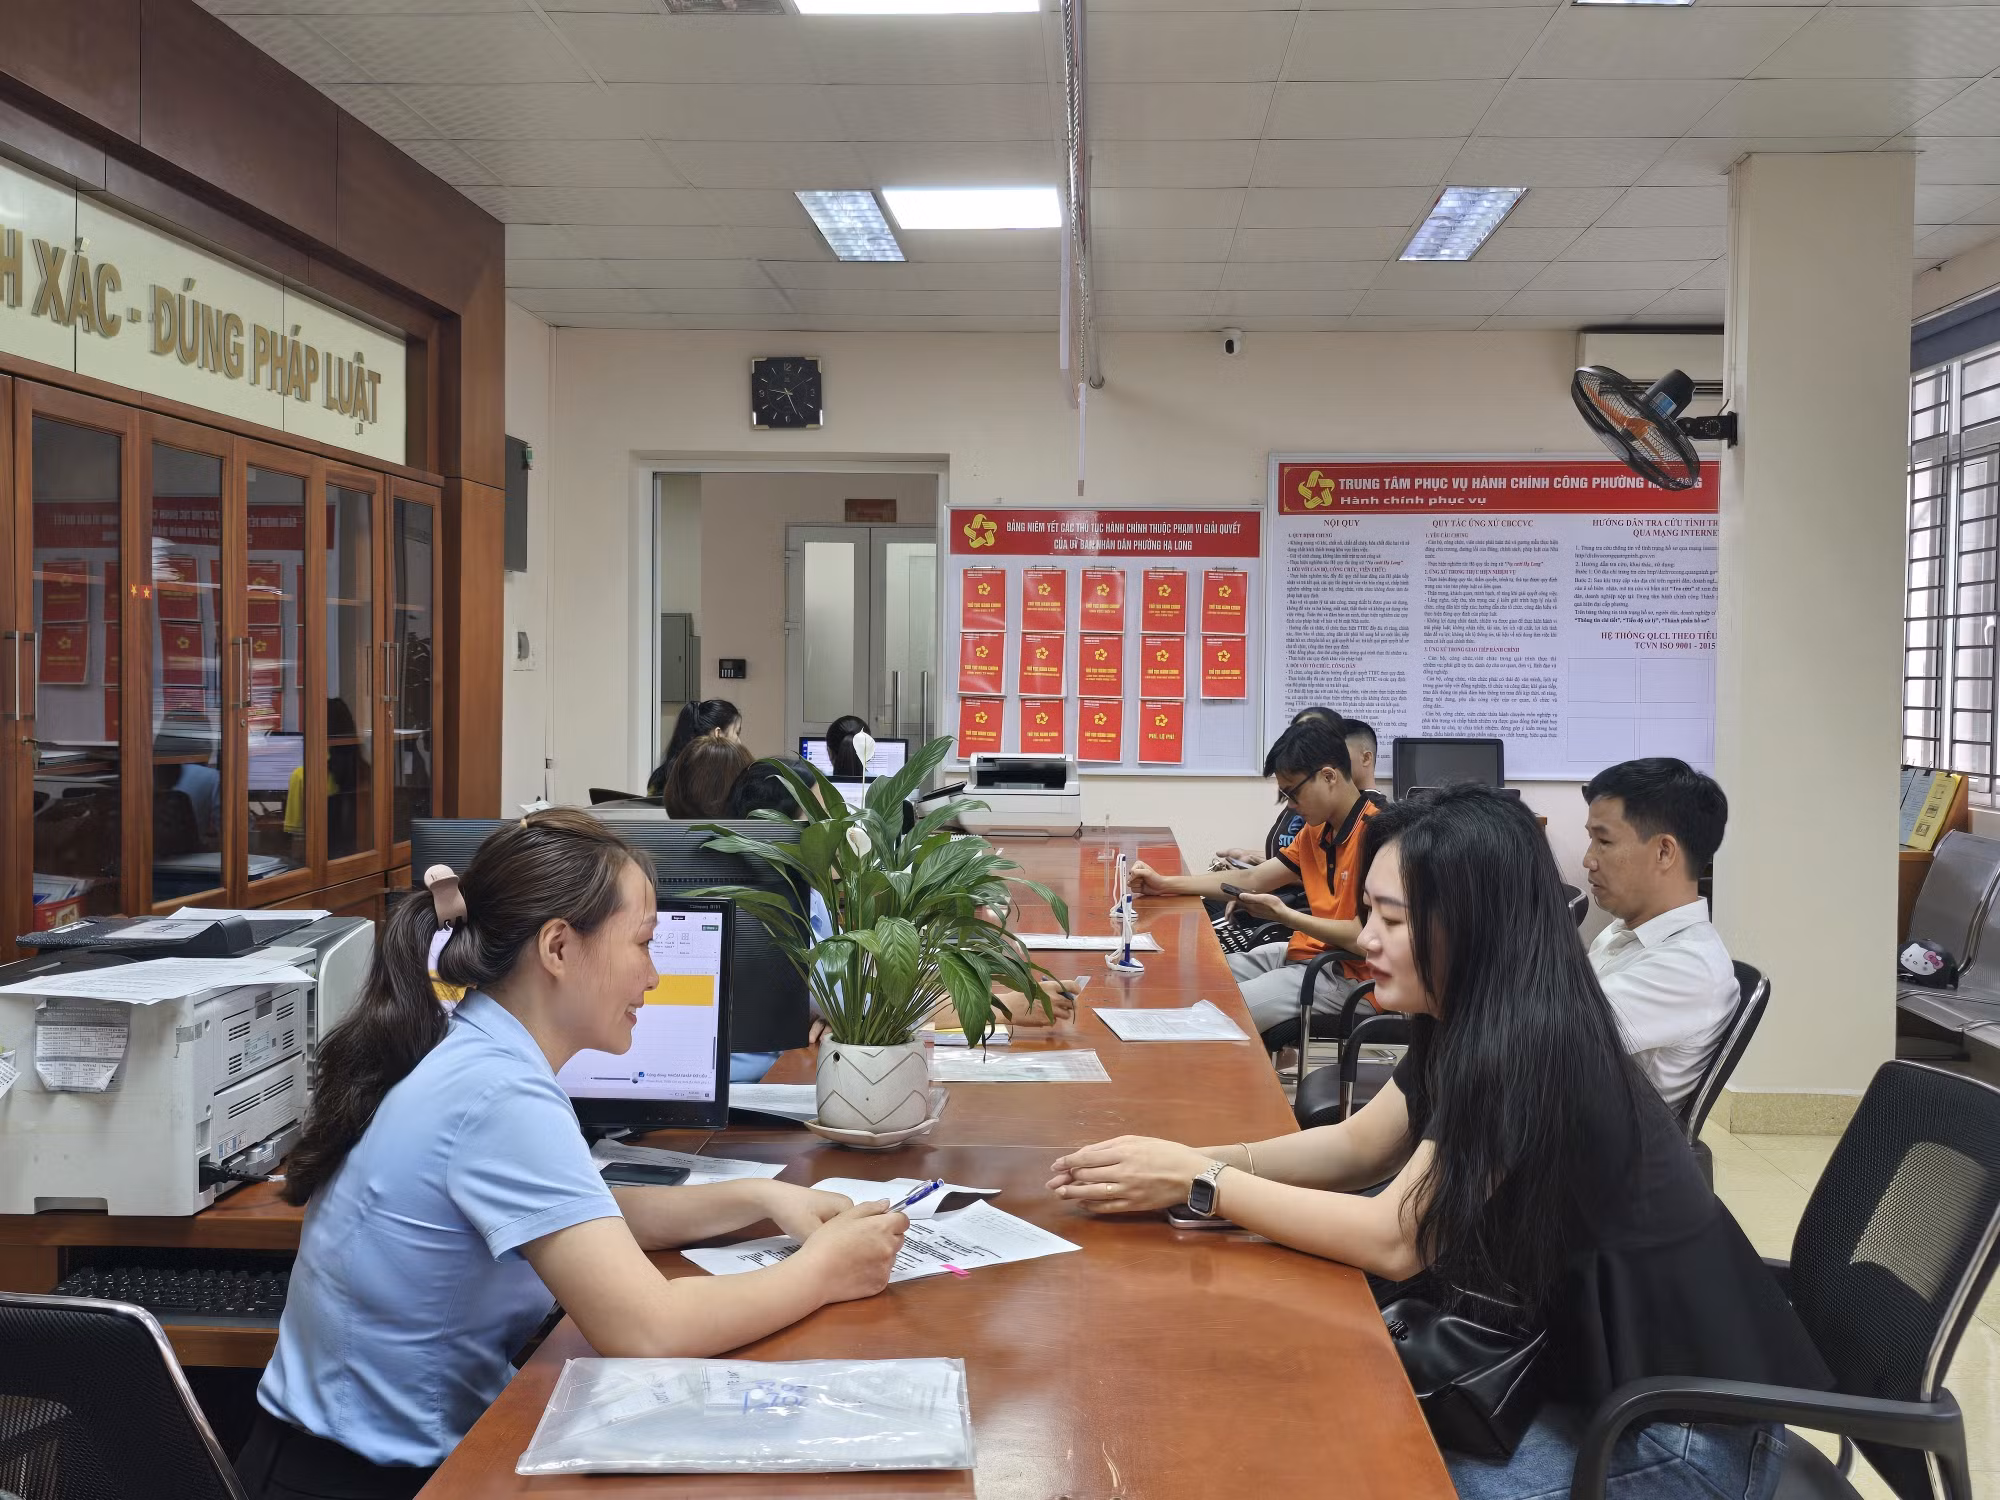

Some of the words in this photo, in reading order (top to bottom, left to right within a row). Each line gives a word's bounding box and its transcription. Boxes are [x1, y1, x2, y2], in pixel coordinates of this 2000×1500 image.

[31, 237, 122, 339] XÁC
[148, 277, 244, 379] ĐÚNG
[250, 324, 319, 402] PHÁP
[322, 351, 382, 435] LUẬT
[1338, 478, 1380, 490] TRUNG
[1384, 476, 1411, 490] TÂM
[1414, 478, 1448, 492] PHỤC
[1452, 478, 1468, 491] VỤ
[1472, 475, 1506, 489] HÀNH
[1511, 475, 1550, 489] CHÍNH
[1554, 475, 1588, 489] CÔNG
[1592, 475, 1644, 489] PHƯỜNG
[1340, 496, 1380, 505] Hành
[1384, 496, 1424, 505] chính
[1428, 496, 1464, 506] phục
[1468, 496, 1486, 506] vụ
[1006, 519, 1026, 532] BẢNG
[1028, 520, 1045, 532] NIÊM
[1047, 520, 1059, 532] YẾT
[1060, 520, 1074, 532] CÁC
[1076, 520, 1088, 532] THỦ
[1091, 523, 1104, 534] TỤC
[1106, 521, 1124, 532] HÀNH
[1126, 522, 1147, 534] CHÍNH
[1149, 522, 1172, 535] THUỘC
[1174, 523, 1194, 536] PHẠM
[1195, 523, 1202, 534] VI
[1204, 521, 1218, 534] GIẢI
[1219, 520, 1242, 534] QUYẾT
[1324, 518, 1340, 528] NỘI
[1341, 519, 1360, 528] QUY
[1432, 520, 1449, 529] QUY
[1450, 518, 1467, 528] TẮC
[1468, 518, 1486, 528] ỨNG
[1487, 518, 1500, 528] XỬ
[1502, 520, 1534, 528] CBCCVC
[1592, 518, 1624, 527] HƯỚNG
[1626, 518, 1644, 527] DẪN
[1646, 519, 1662, 527] TRA
[1664, 518, 1684, 527] CỨU
[1686, 518, 1705, 527] TÌNH
[1633, 530, 1650, 538] QUA
[1652, 530, 1678, 538] MẠNG
[1054, 536, 1068, 550] CỦA
[1080, 539, 1094, 550] BAN
[1096, 538, 1116, 550] NHÂN
[1118, 538, 1132, 550] DÂN
[1134, 538, 1161, 550] PHƯỜNG
[1163, 540, 1172, 552] HẠ
[1174, 540, 1192, 550] LONG
[1601, 632, 1612, 640] HỆ
[1614, 630, 1645, 640] THỐNG
[1647, 632, 1670, 641] QLCL
[1672, 632, 1696, 640] THEO
[1634, 642, 1658, 650] TCVN
[1660, 642, 1674, 650] ISO
[1676, 642, 1692, 650] 9001
[1699, 642, 1716, 650] 2015
